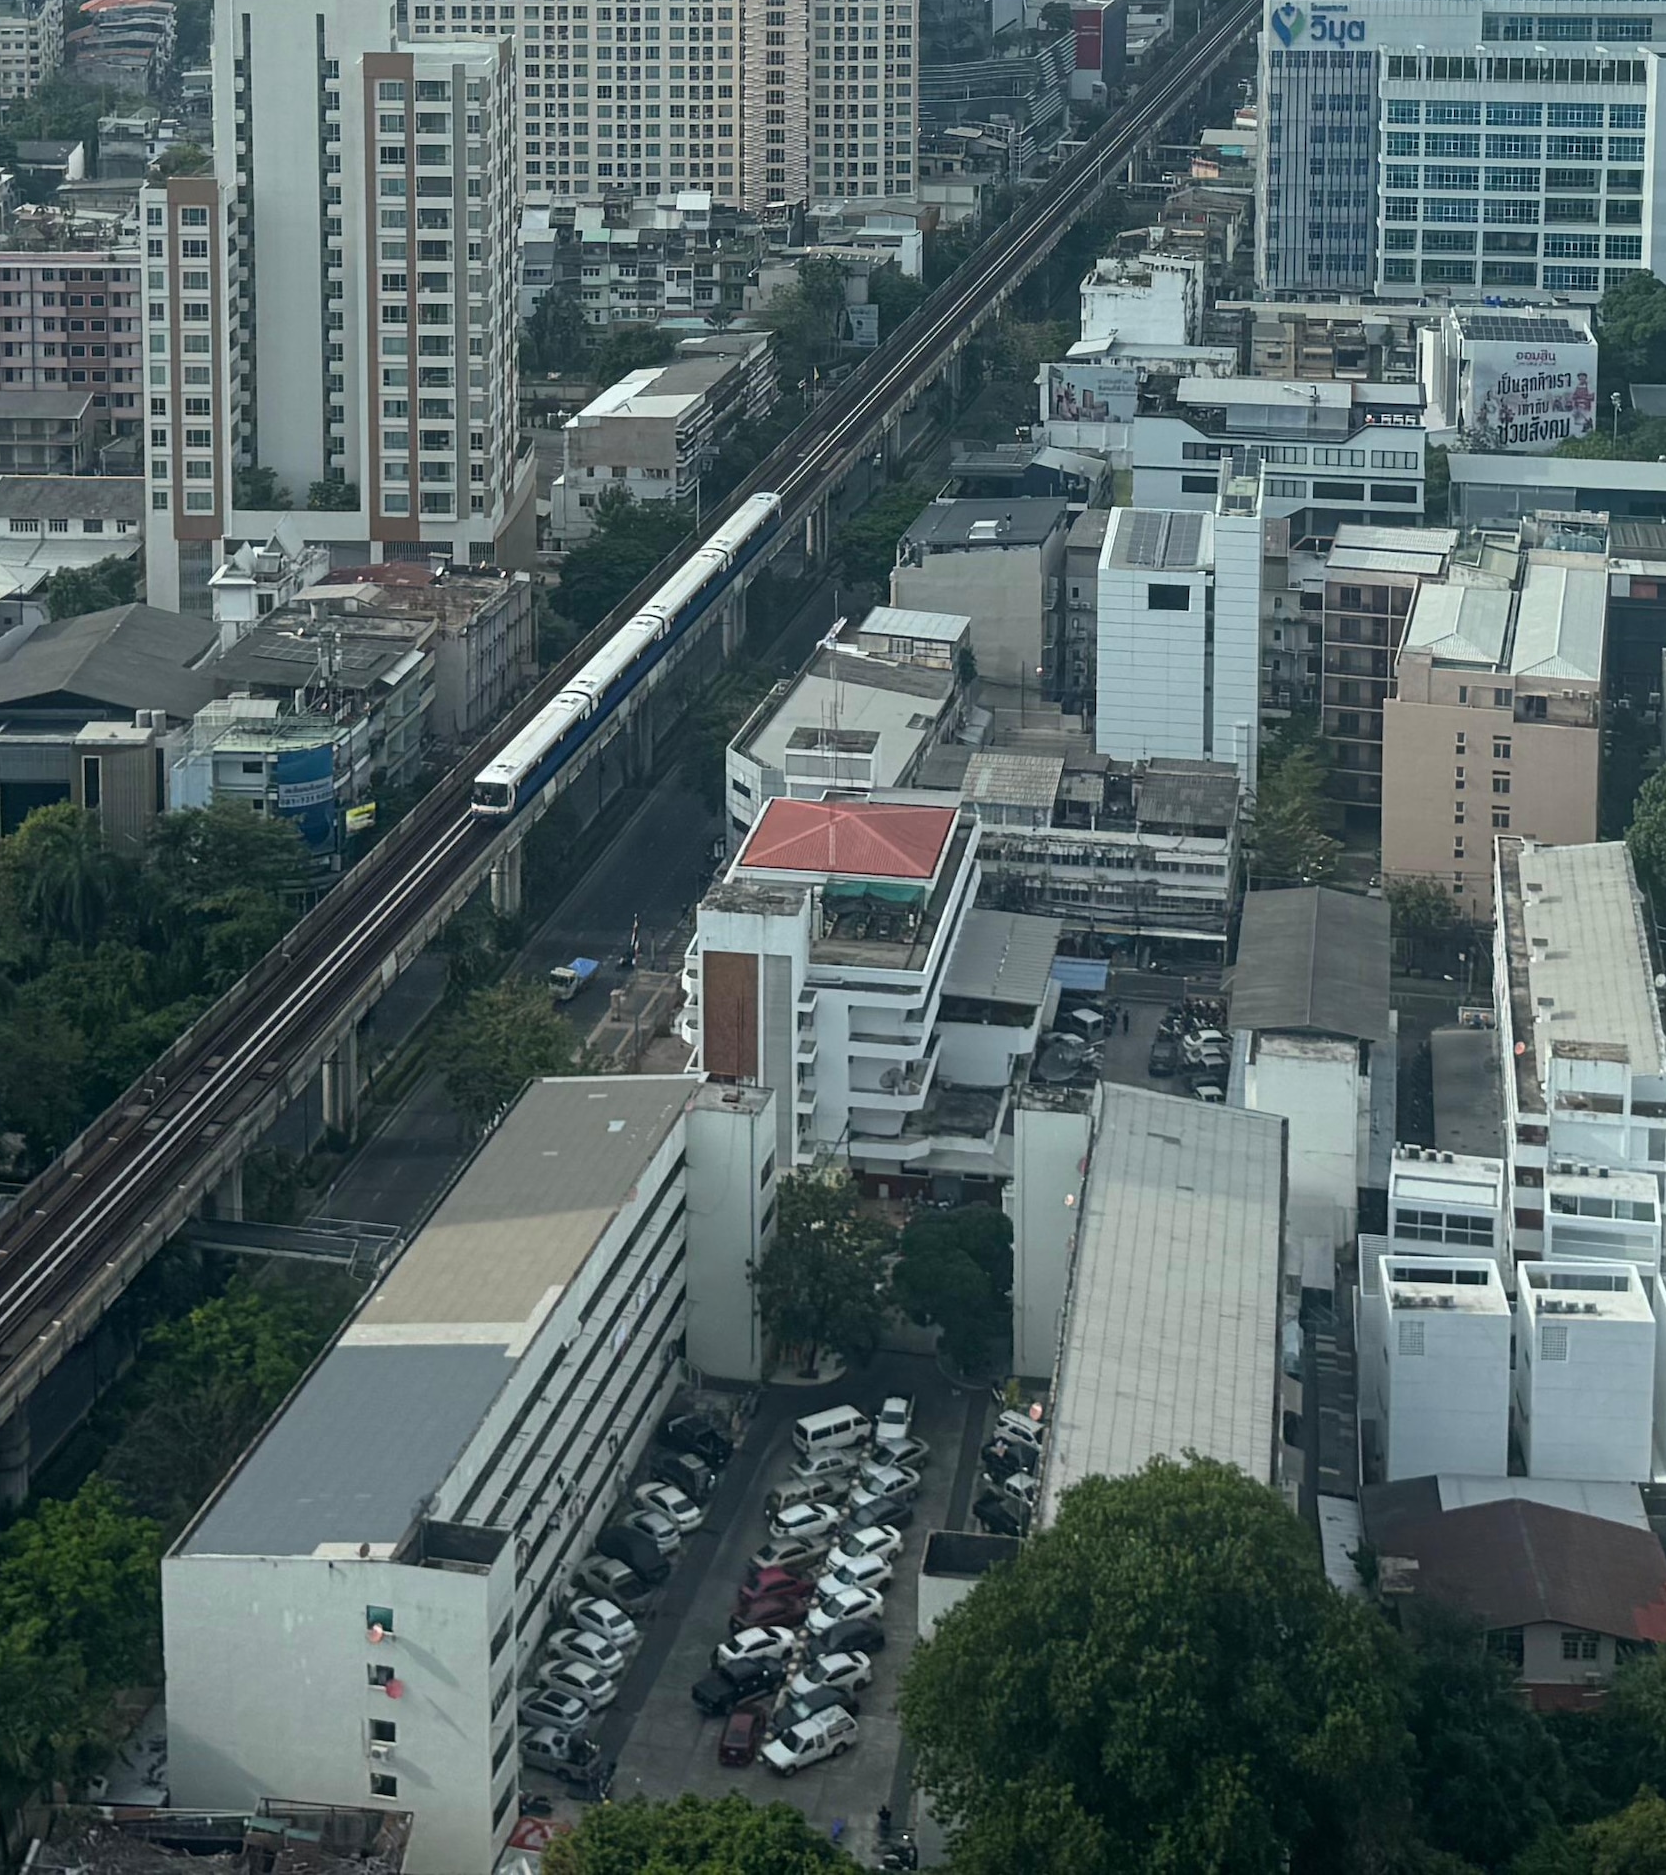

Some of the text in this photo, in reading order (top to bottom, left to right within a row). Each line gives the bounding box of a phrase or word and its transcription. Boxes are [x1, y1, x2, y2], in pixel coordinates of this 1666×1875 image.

[1311, 15, 1365, 49] วิมุต
[1497, 372, 1571, 399] เป็นลูกค้าเรา
